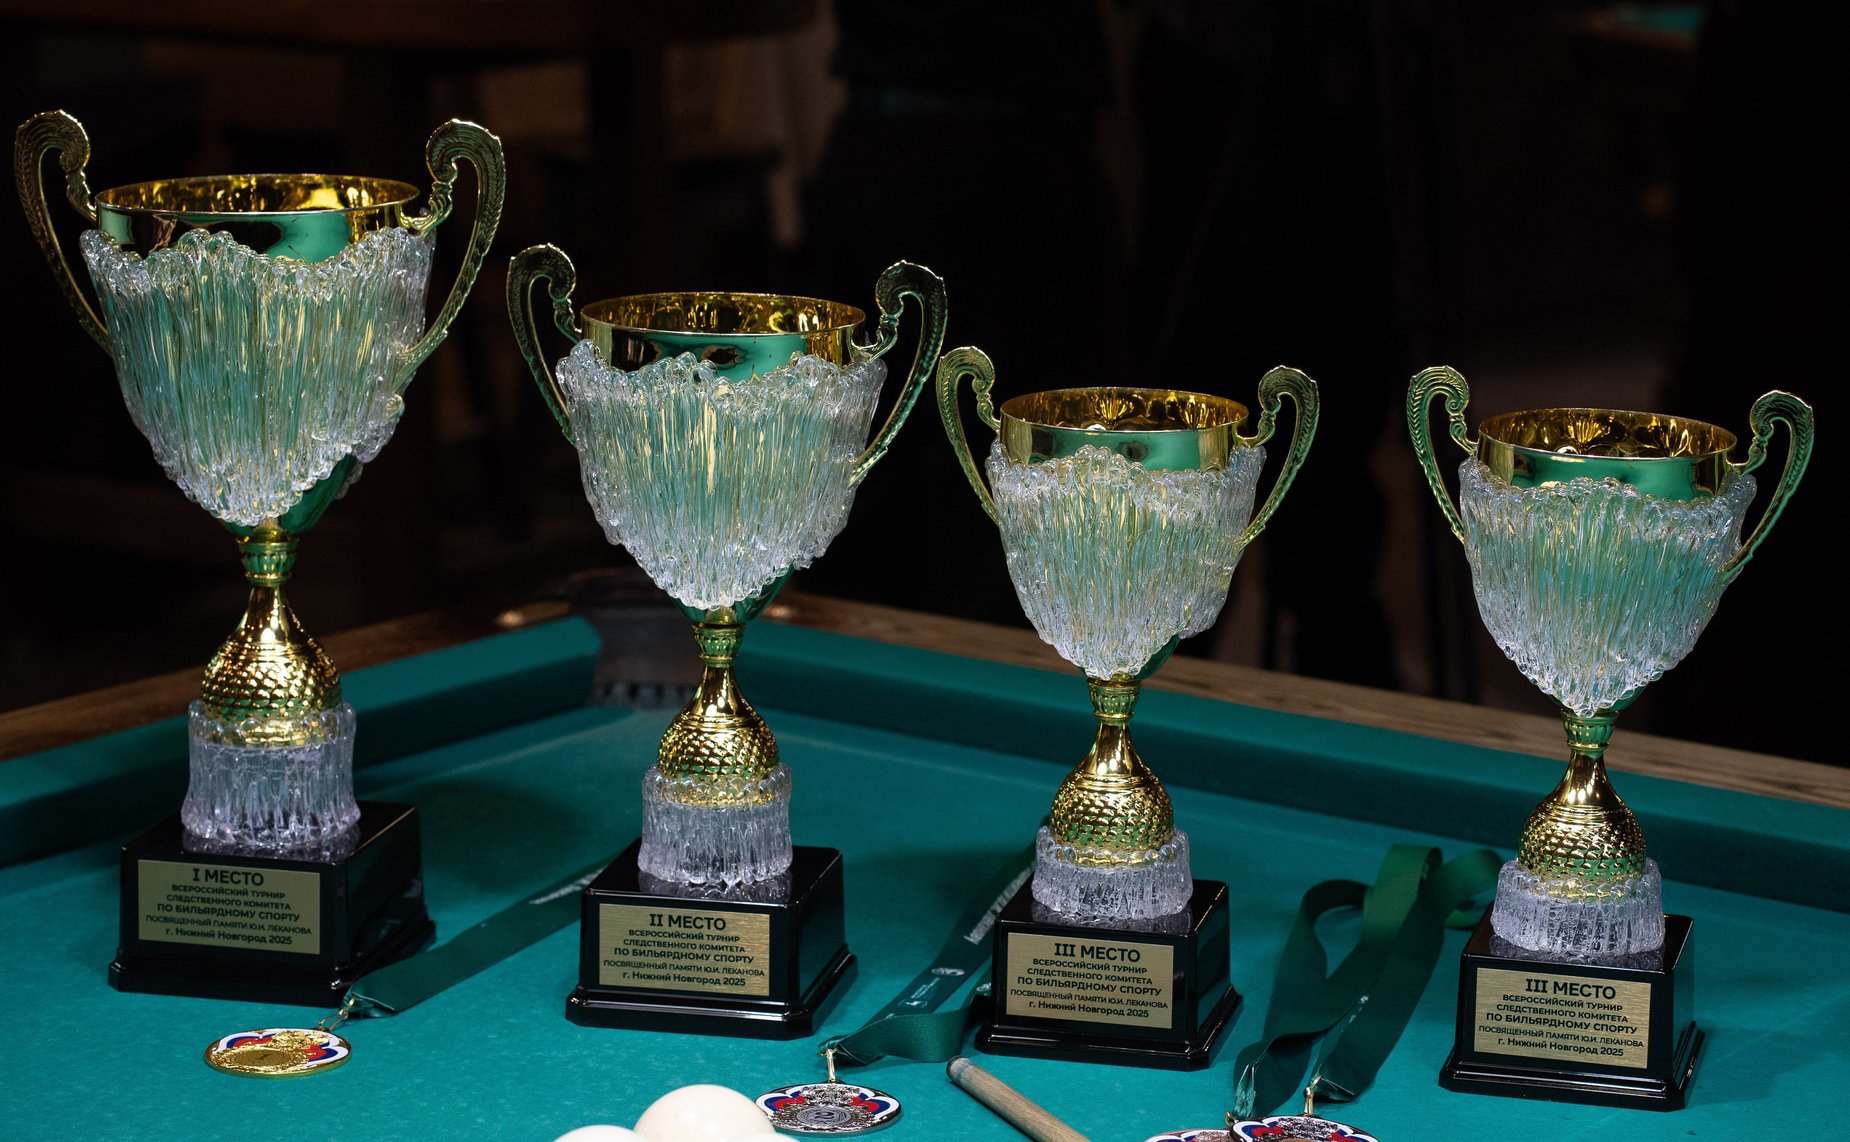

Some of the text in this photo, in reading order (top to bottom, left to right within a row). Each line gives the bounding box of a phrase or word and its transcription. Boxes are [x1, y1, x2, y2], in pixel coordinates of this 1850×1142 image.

[205, 869, 264, 886] МЕСТО
[172, 884, 285, 899] ВСЕРОССИЙСКИЙ ТУРНИР
[167, 894, 291, 910] СЛЕДСТВЕННОГО КОМИТЕТА
[157, 903, 300, 922] ПО БИЛЬЯРДНОМУ СПОРТУ
[146, 915, 211, 926] ПОСВЯЩЕННЫЙ
[213, 921, 247, 929] ПАМЯТИ
[268, 925, 312, 934] ЛЕКАНОВА
[668, 915, 726, 931] МЕСТО
[176, 928, 215, 938] Нижний
[218, 932, 267, 944] Новгород
[269, 936, 292, 945] 2025
[629, 929, 704, 940] ВСЕРОССИЙСКИЙ
[624, 939, 745, 953] СЛЕДСТВЕННОГО КОМИТЕТА
[1081, 945, 1141, 962] МЕСТО
[632, 950, 710, 961] БИЛЬЯРДНОМУ
[714, 955, 754, 964] СПОРТУ
[604, 960, 667, 970] ПОСВЯЩЕННЫЙ
[722, 968, 765, 976] ЛЕКАНОВА
[1033, 958, 1147, 974] ВСЕРОССИЙСКИЙ ТУРНИР
[632, 972, 670, 981] Нижний
[673, 976, 721, 986] Новгород
[723, 978, 746, 986] 2025
[1027, 968, 1152, 984] СЛЕДСТВЕННОГО КОМИТЕТА
[1036, 979, 1117, 992] БИЛЬЯРДНОМУ
[1120, 986, 1161, 996] СПОРТУ
[1553, 981, 1616, 999] МЕСТО
[1011, 989, 1072, 1000] ПОСВЯЩЕННЫЙ
[1074, 995, 1106, 1003] ПАМЯТИ
[1125, 999, 1168, 1009] ЛЕКАНОВА
[1503, 994, 1623, 1011] ВСЕРОССИЙСКИЙ ТУРНИР
[1038, 1001, 1076, 1012] Нижний
[1078, 1005, 1124, 1017] Новгород
[1127, 1009, 1149, 1017] 2025
[1497, 1004, 1628, 1023] СЛЕДСТВЕННОГО КОМИТЕТА
[1487, 1012, 1638, 1034] ПО БИЛЬЯРДНОМУ СПОРТУ
[1479, 1026, 1543, 1038] ПОСВЯЩЕННЫЙ
[1546, 1032, 1579, 1041] ПАМЯТИ
[1600, 1037, 1643, 1047] ЛЕКАНОВА
[1508, 1038, 1547, 1048] Нижний
[1550, 1042, 1598, 1055] Новгород
[1600, 1047, 1624, 1056] 2025
